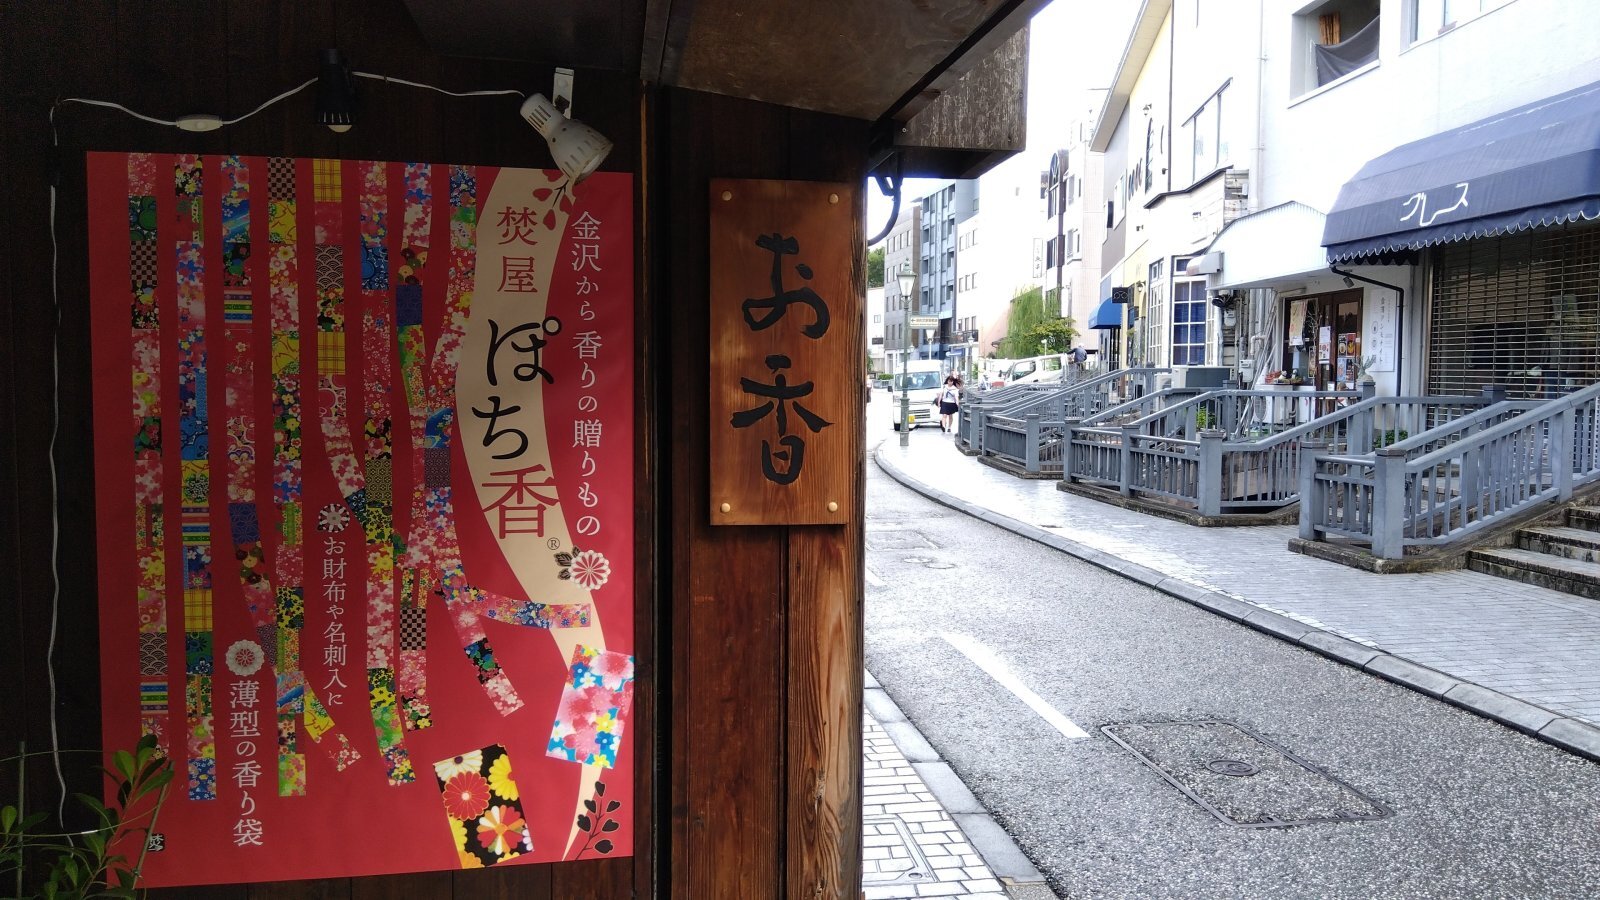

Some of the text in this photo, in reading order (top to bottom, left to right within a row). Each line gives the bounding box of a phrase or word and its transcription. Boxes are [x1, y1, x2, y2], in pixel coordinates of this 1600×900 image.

[496, 206, 539, 293] 焚屋
[471, 315, 562, 540] ぽち香
[571, 211, 602, 536] 金沢から香りの贈りもの
[730, 232, 836, 486] お香
[322, 536, 348, 706] お財布や名刺入に
[229, 680, 264, 847] 薄型の香り袋
